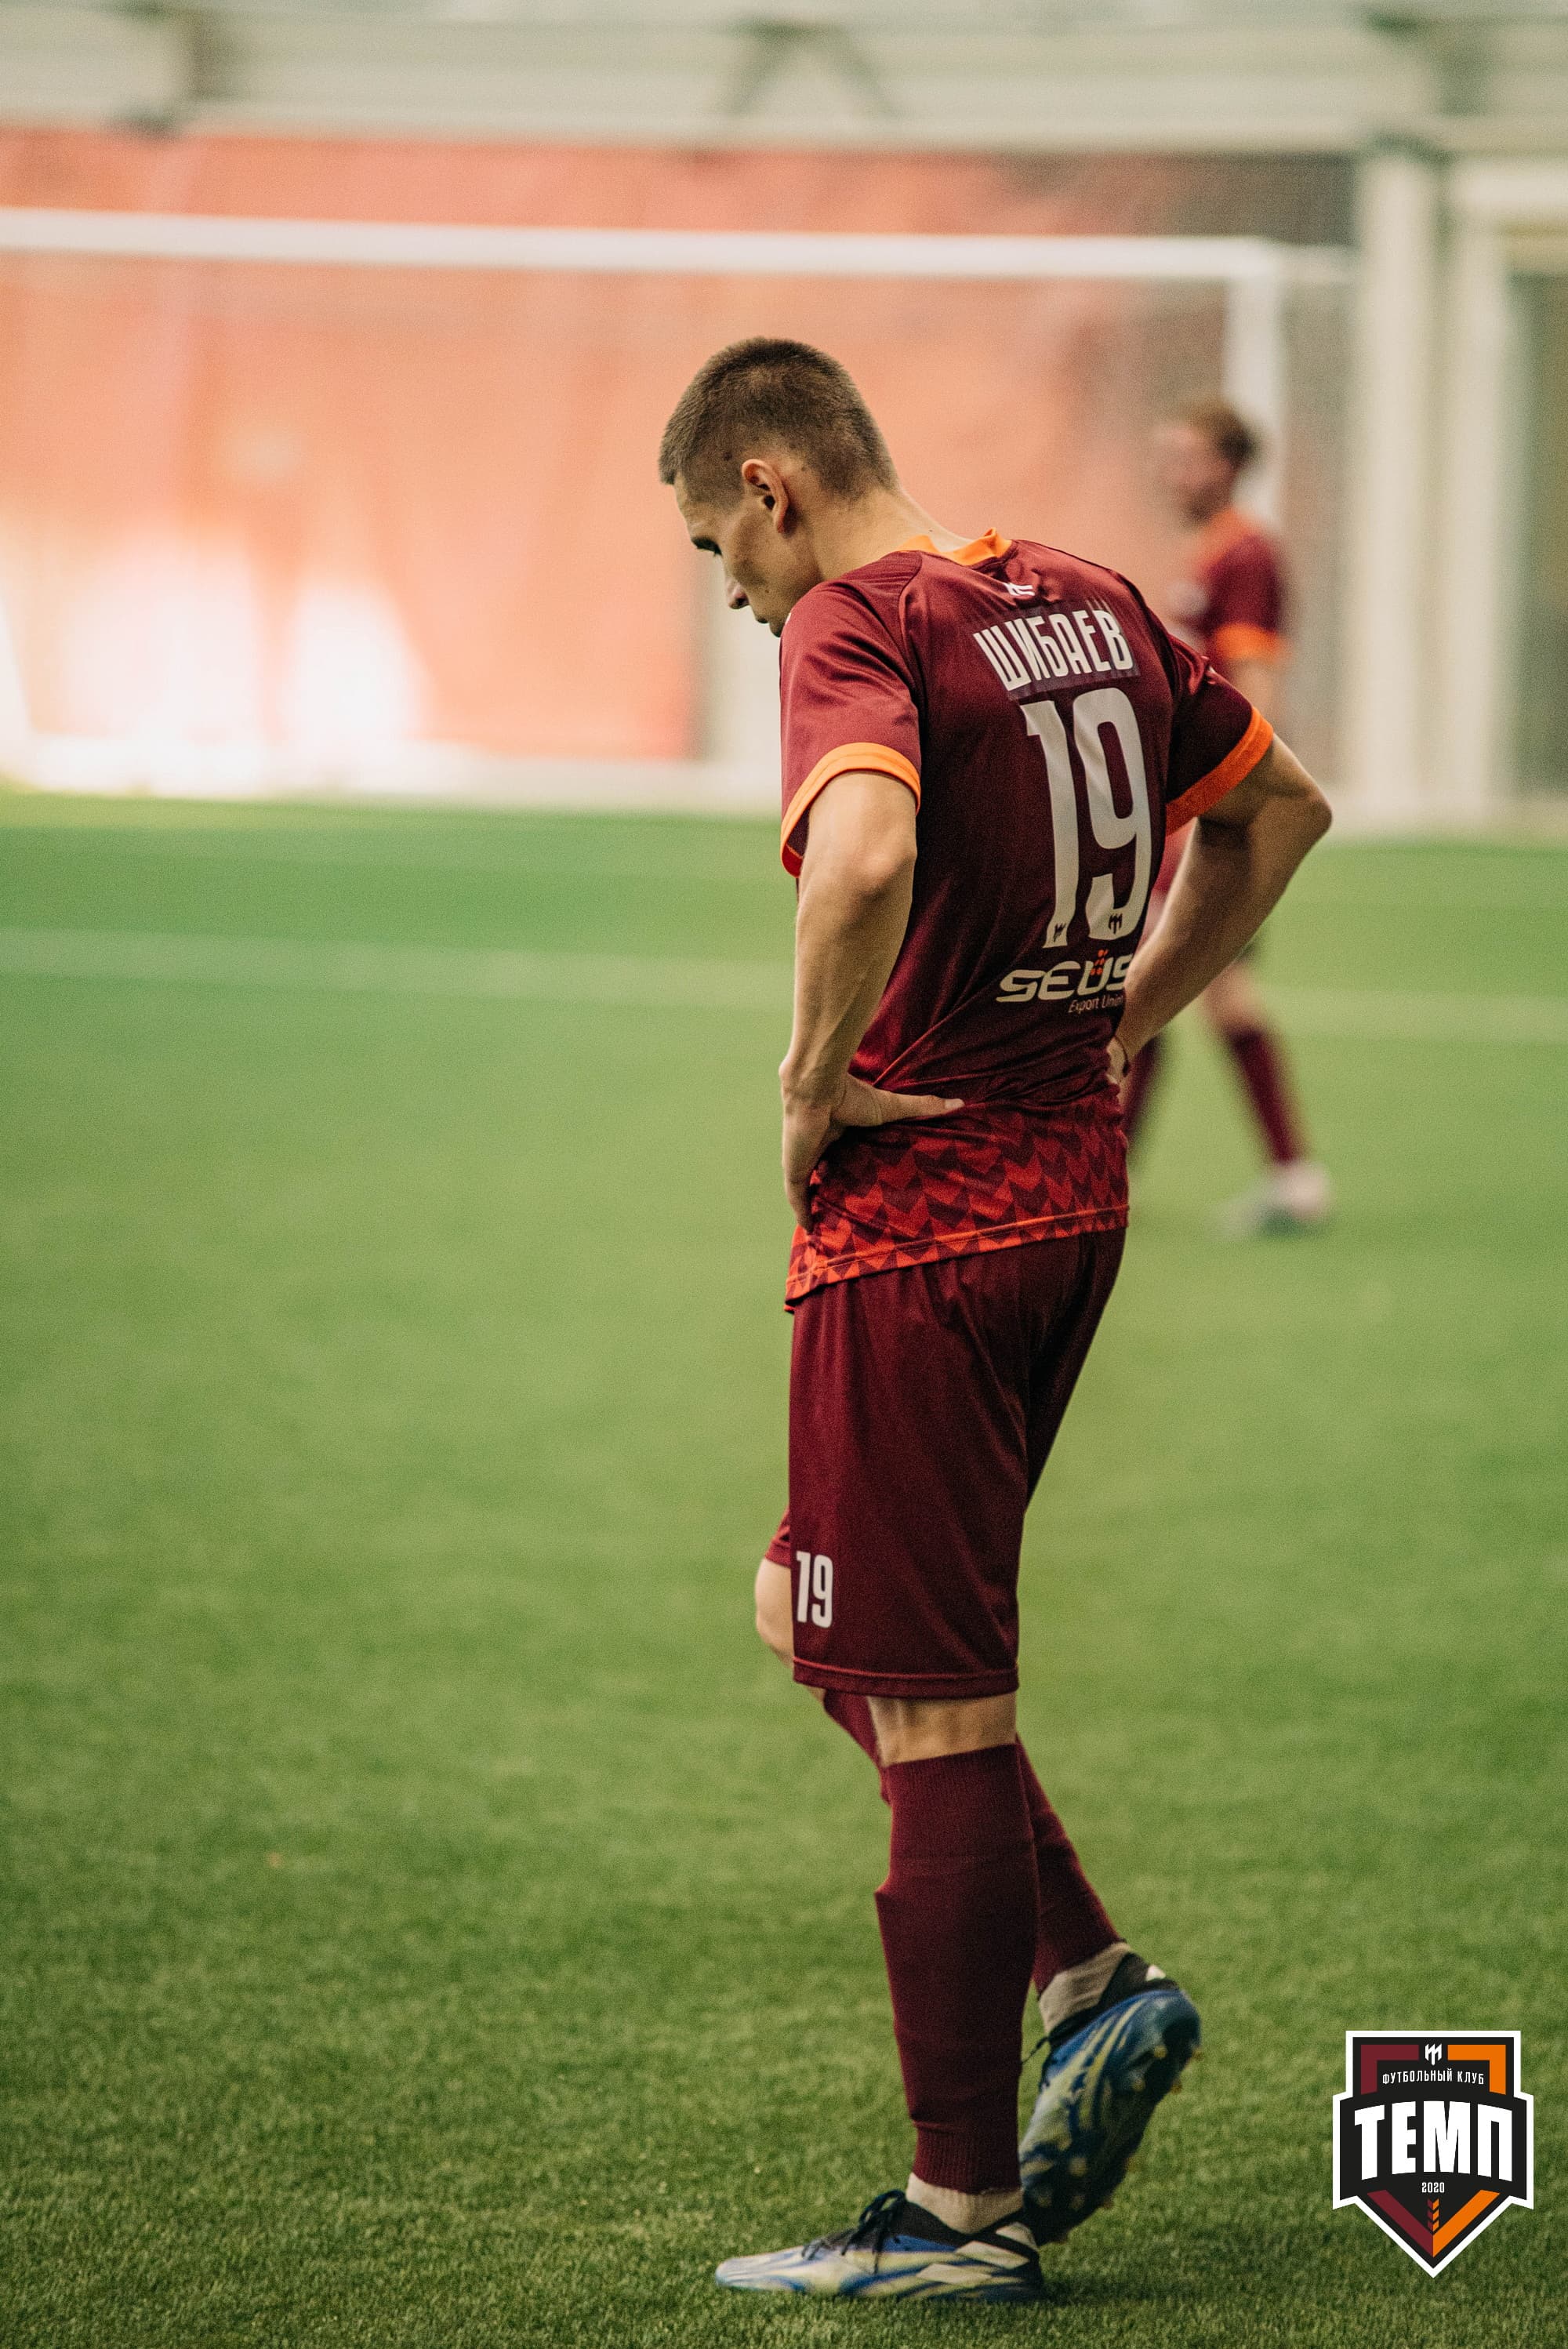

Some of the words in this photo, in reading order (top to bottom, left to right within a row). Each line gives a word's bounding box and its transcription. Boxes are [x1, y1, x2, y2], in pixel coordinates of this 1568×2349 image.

[973, 609, 1134, 692] ШИБАЕВ
[1020, 687, 1152, 949] 19
[796, 1550, 833, 1628] 19
